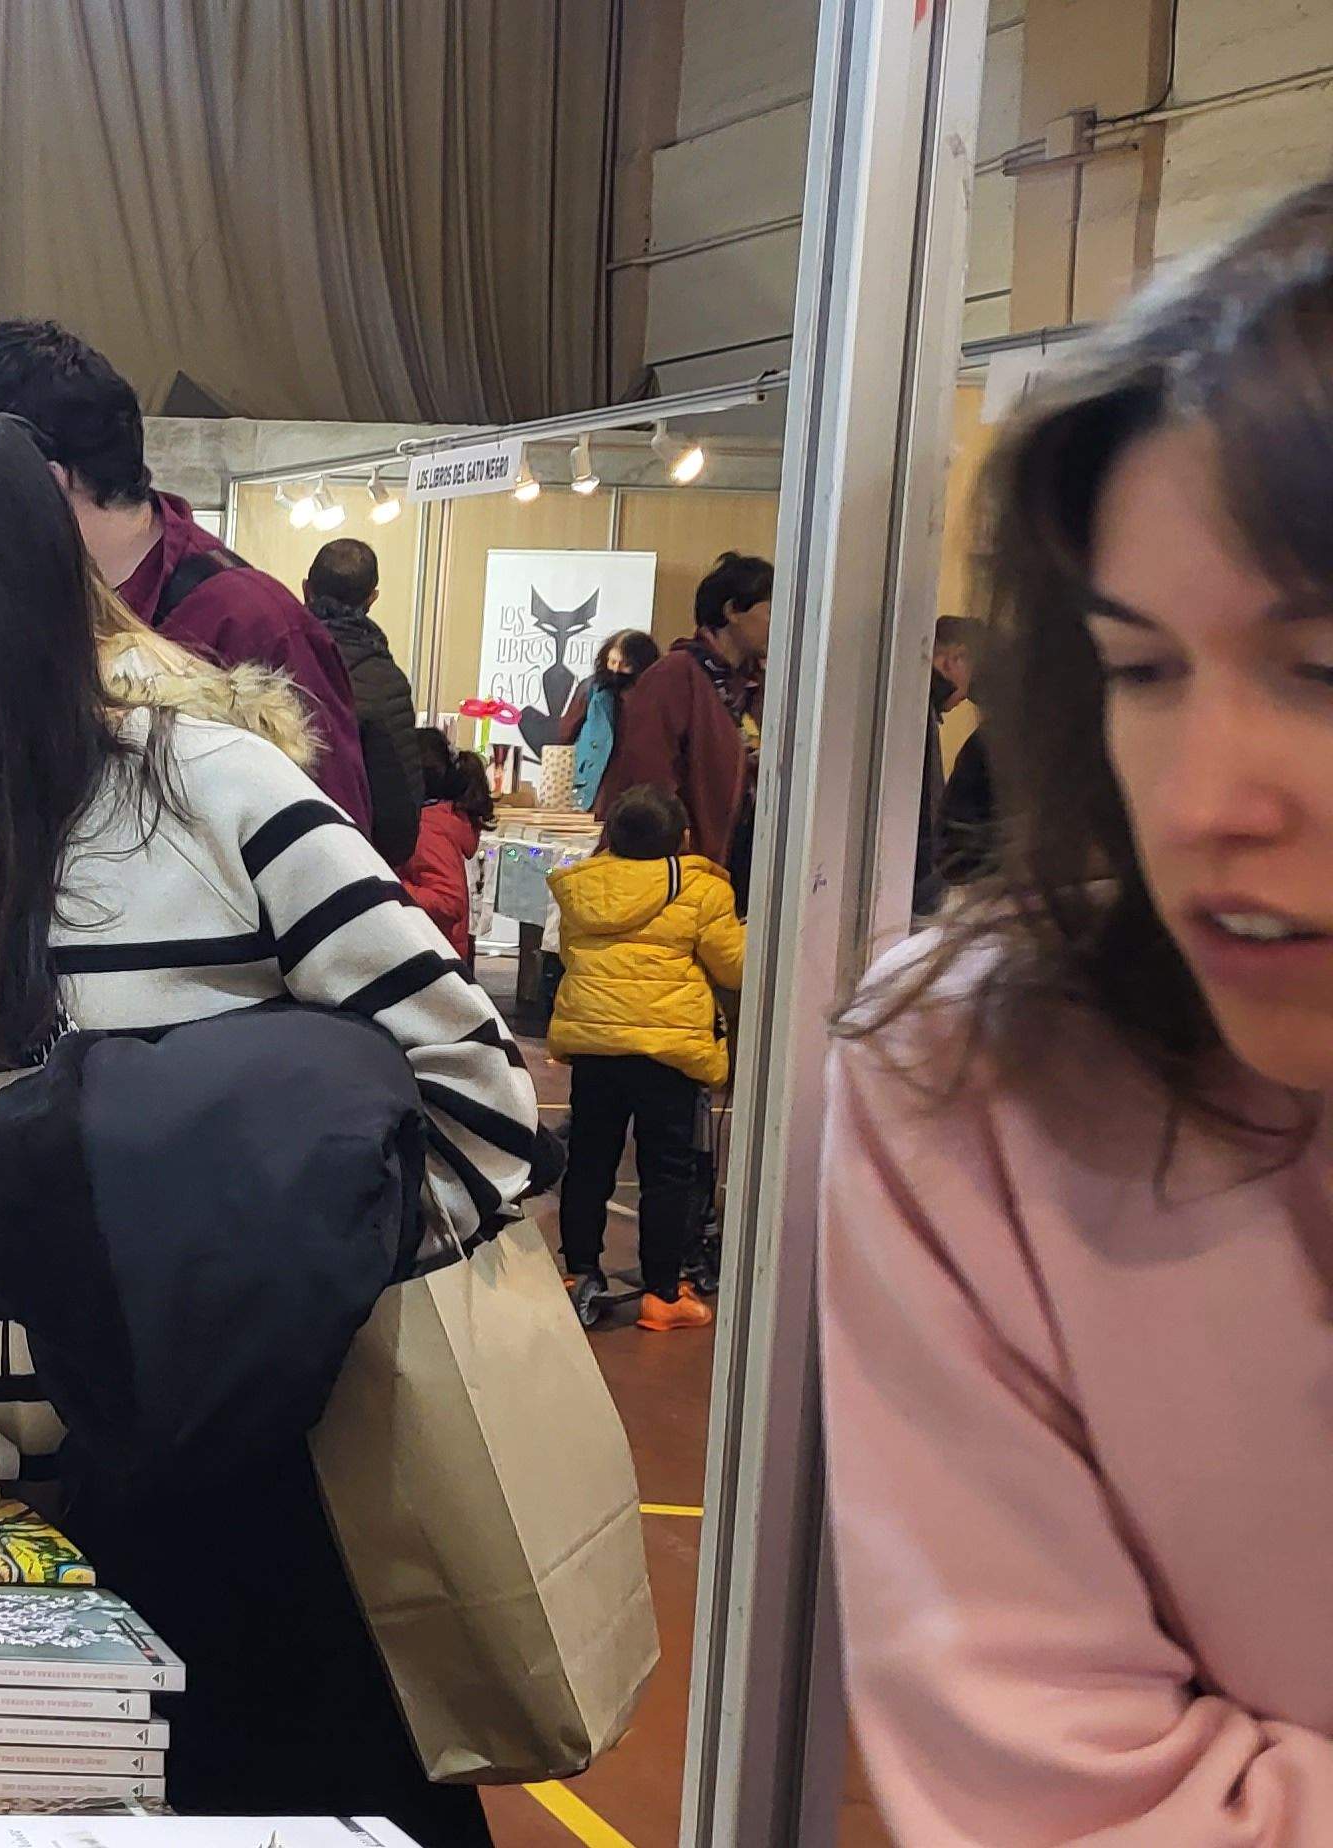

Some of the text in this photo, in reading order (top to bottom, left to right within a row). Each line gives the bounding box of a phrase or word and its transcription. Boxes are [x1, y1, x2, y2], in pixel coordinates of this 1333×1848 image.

[416, 456, 509, 491] LOS LIBROS DEL GATO NEGRO
[499, 604, 527, 633] LOS
[495, 634, 556, 666] LIBROS
[490, 664, 545, 706] GATO
